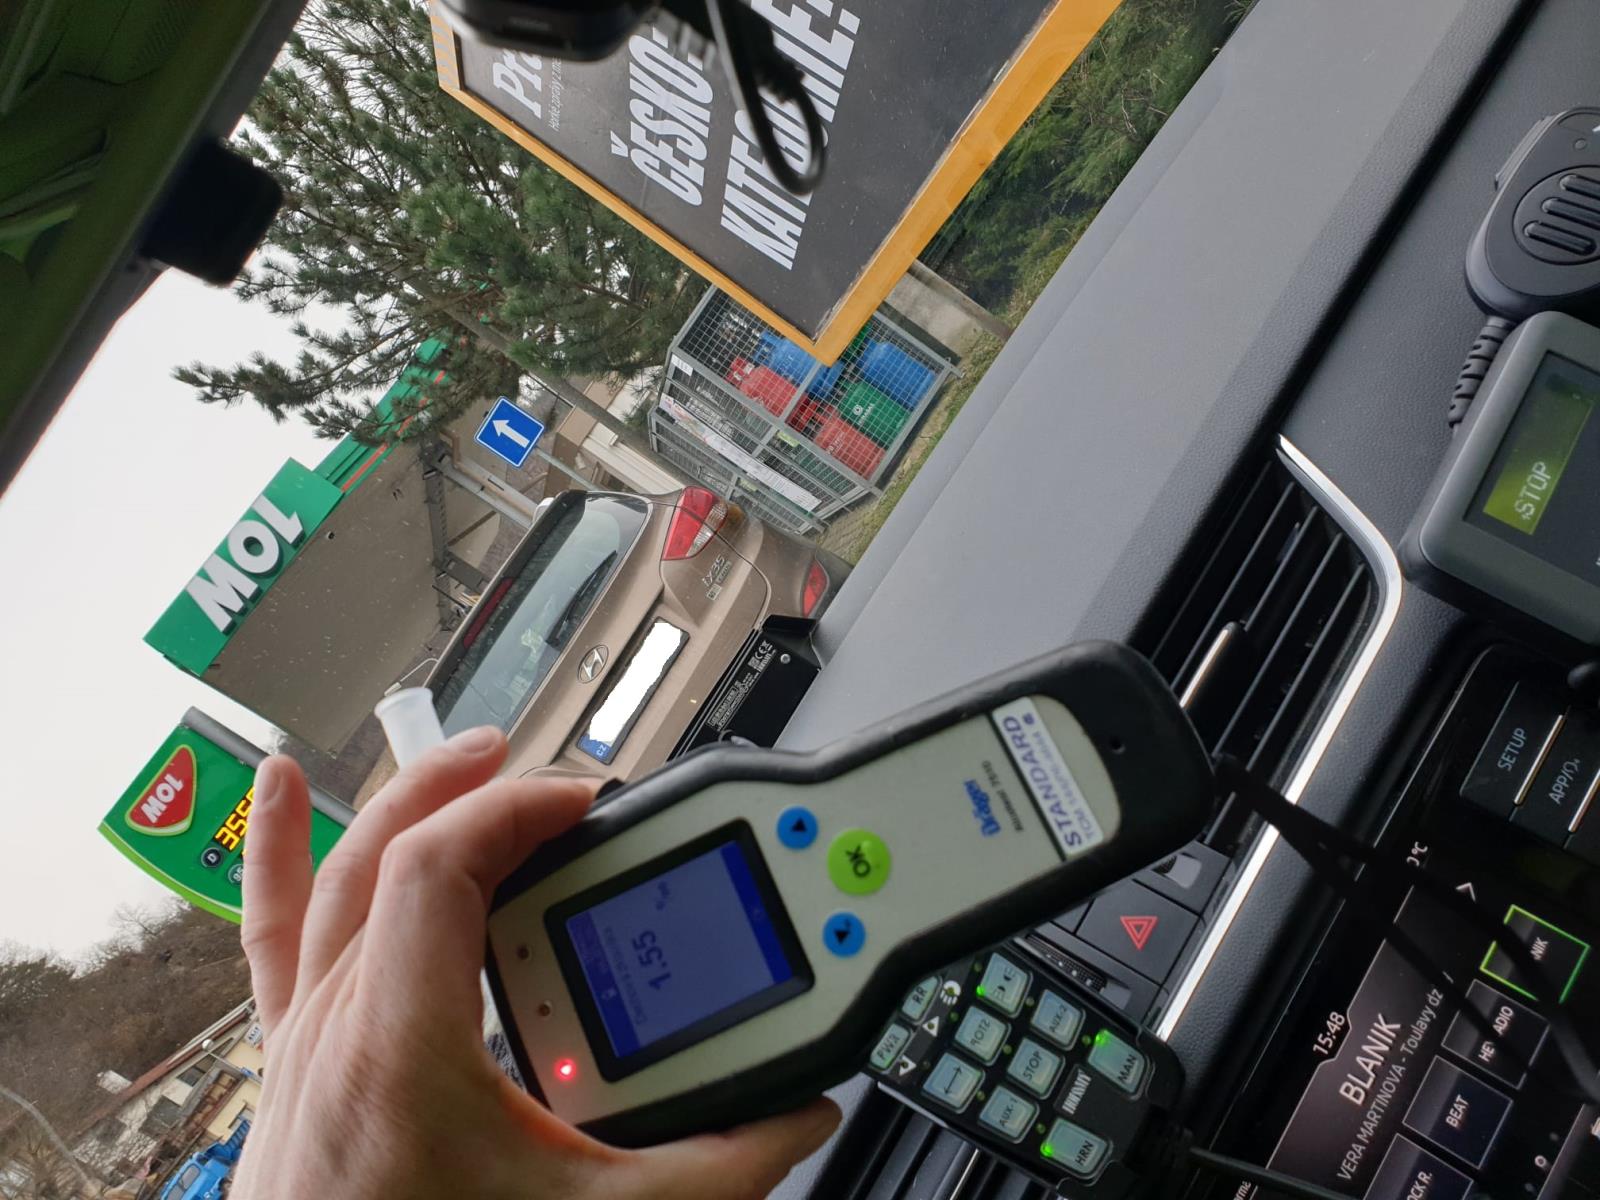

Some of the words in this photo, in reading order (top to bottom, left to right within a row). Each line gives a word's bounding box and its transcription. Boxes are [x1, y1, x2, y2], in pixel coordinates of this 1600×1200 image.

[1514, 461, 1549, 515] STOP
[186, 495, 303, 633] MOL
[596, 744, 606, 756] CZ
[1498, 728, 1527, 772] SETUP
[141, 772, 184, 824] MOL
[1004, 715, 1082, 847] STANDARD
[846, 845, 871, 878] OK
[632, 929, 673, 990] 1.55
[1312, 1011, 1346, 1055] 15:48
[1492, 1006, 1514, 1035] ADIO
[1023, 1051, 1042, 1081] STOP
[1117, 1054, 1138, 1084] MAN
[1338, 1013, 1401, 1106] BLANIK
[1336, 1142, 1366, 1181] VERA
[1359, 1063, 1406, 1149] MARTINOVA
[1400, 1006, 1441, 1060] Toulavy
[1445, 1094, 1470, 1129] BEAT
[1075, 1140, 1095, 1166] HRN
